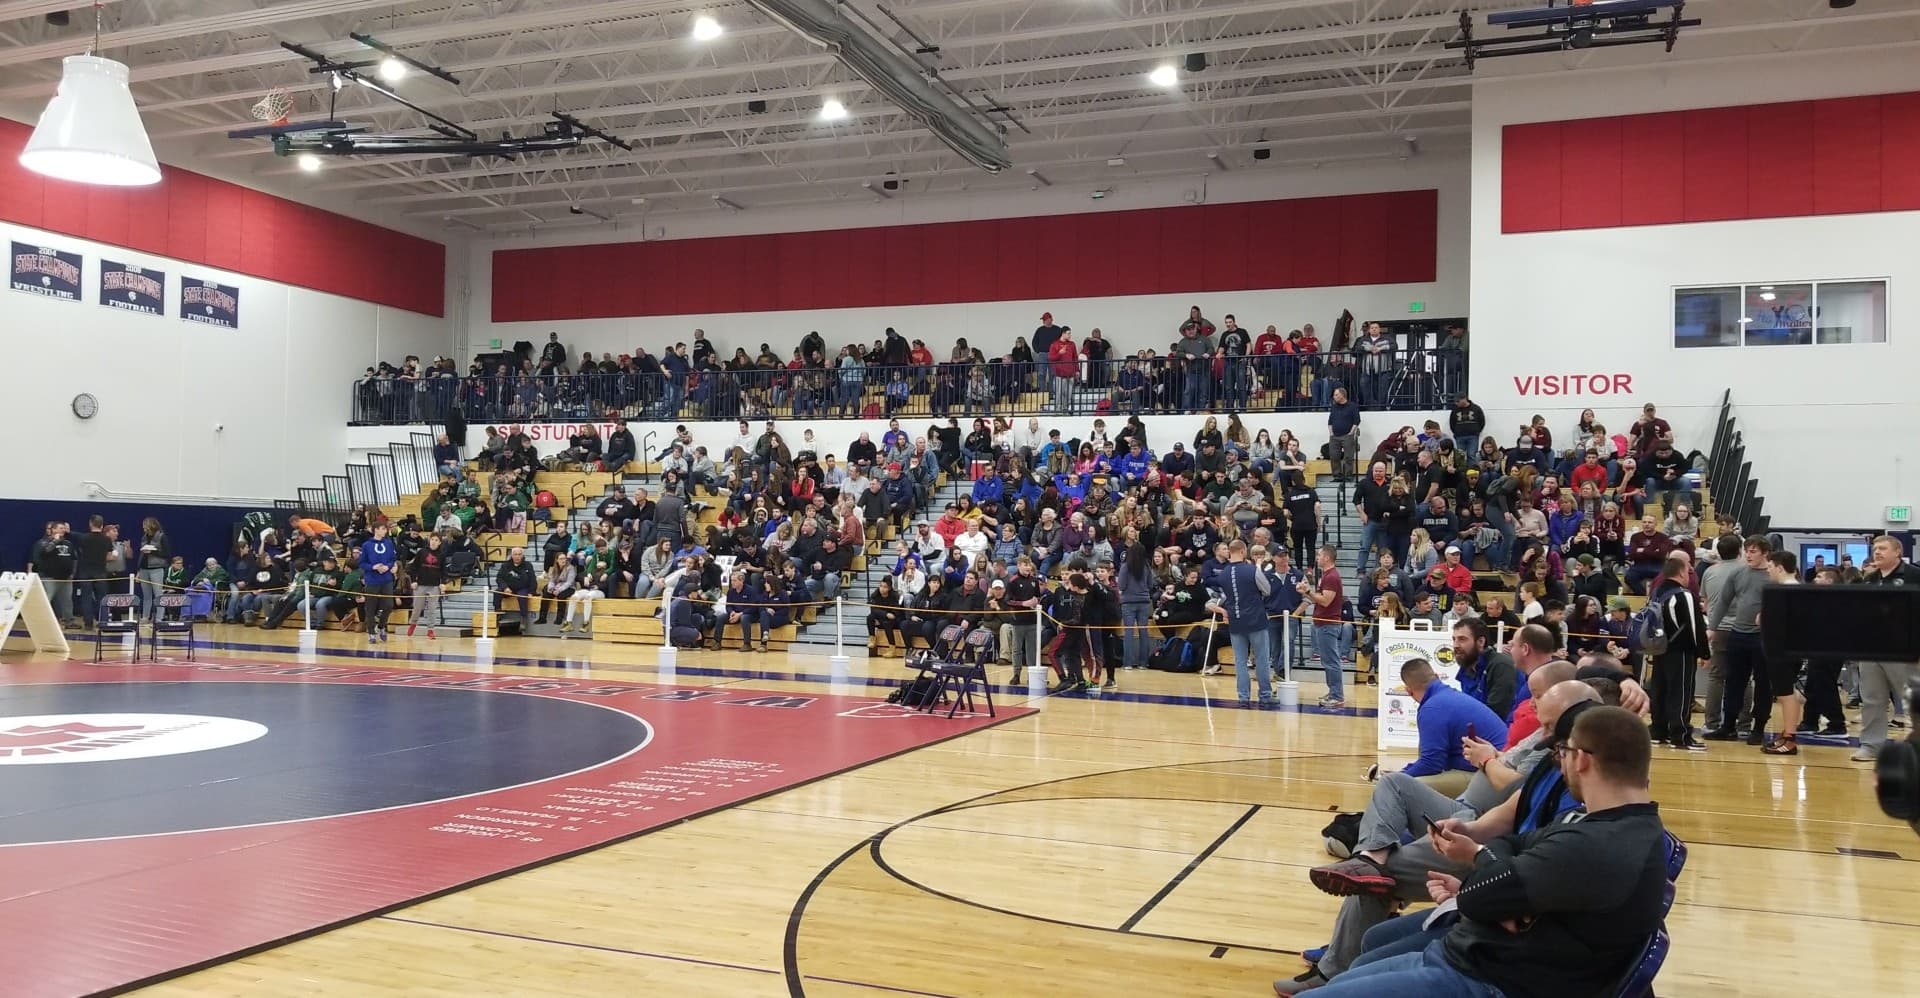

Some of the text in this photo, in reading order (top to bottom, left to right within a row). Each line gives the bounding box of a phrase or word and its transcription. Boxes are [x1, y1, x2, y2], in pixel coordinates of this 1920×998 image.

[16, 254, 80, 286] STATE CHAMPIONS
[13, 281, 74, 299] WRESTLING
[103, 271, 161, 301] STATE CHAMPIONS
[109, 299, 158, 314] FOOTBALL
[184, 286, 236, 314] STATE CHAMPIONS
[187, 313, 233, 327] FOOTBALL
[1513, 374, 1633, 396] VISITOR
[1891, 508, 1908, 520] EXIT
[107, 596, 133, 607] SW
[160, 596, 187, 607] SW
[1385, 643, 1405, 655] CROSS
[1405, 643, 1434, 661] TRAINING
[198, 664, 819, 709] WRESTLING
